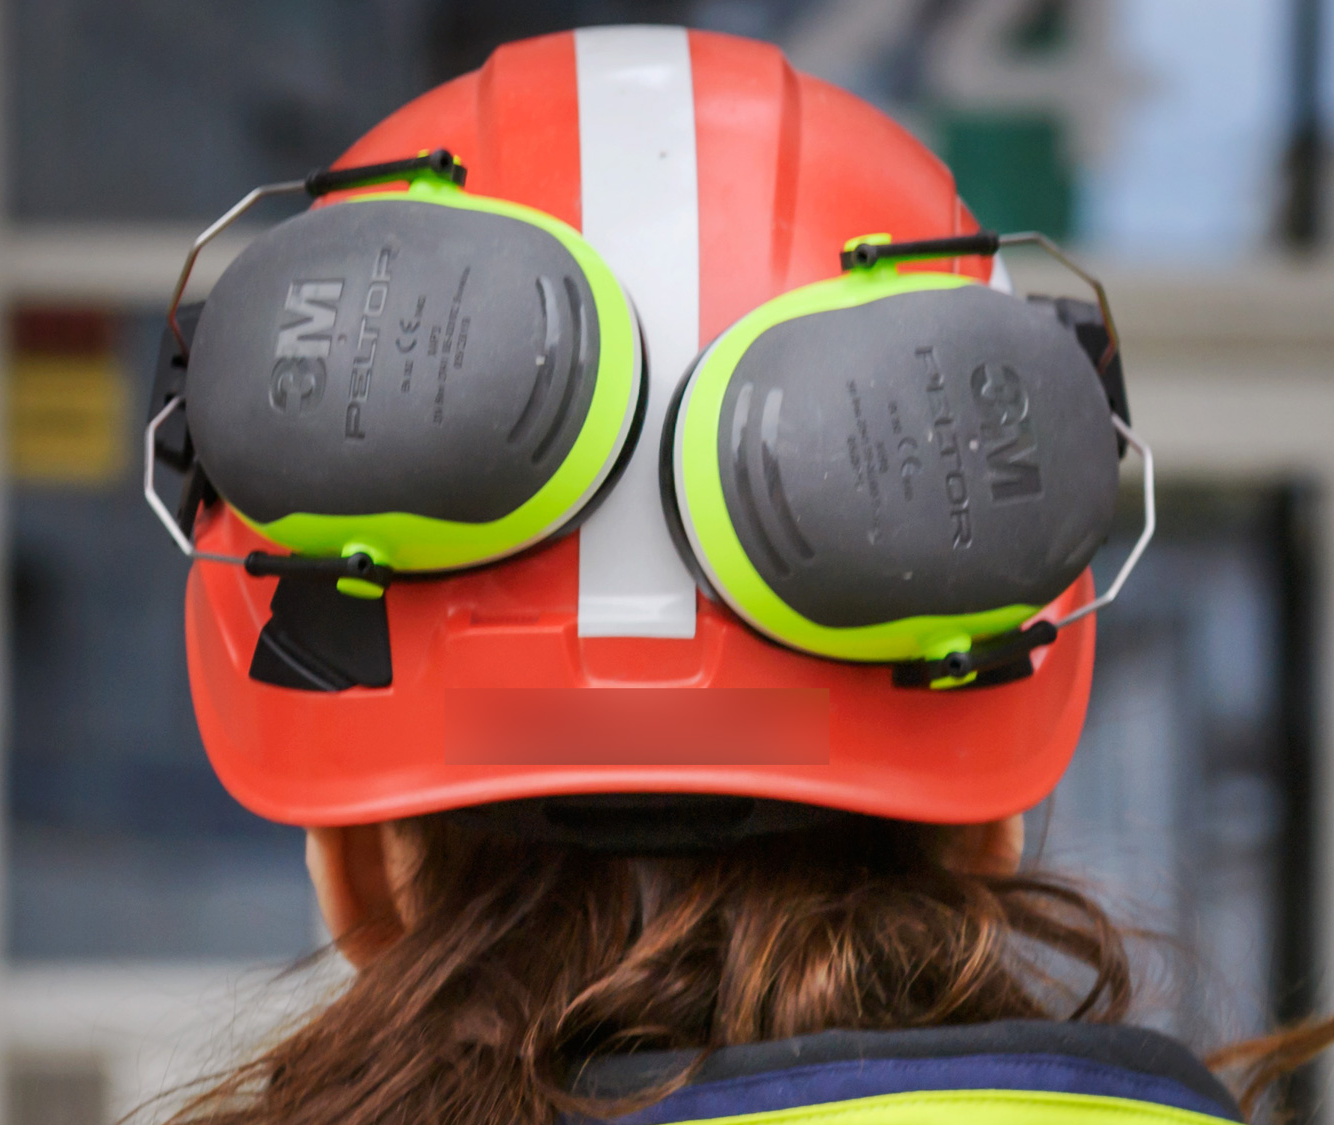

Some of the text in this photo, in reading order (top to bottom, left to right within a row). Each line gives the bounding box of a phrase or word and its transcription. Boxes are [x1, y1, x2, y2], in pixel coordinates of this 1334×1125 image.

[270, 280, 344, 413] 3M
[346, 240, 397, 441] PELTOR
[970, 363, 1044, 502] 3M
